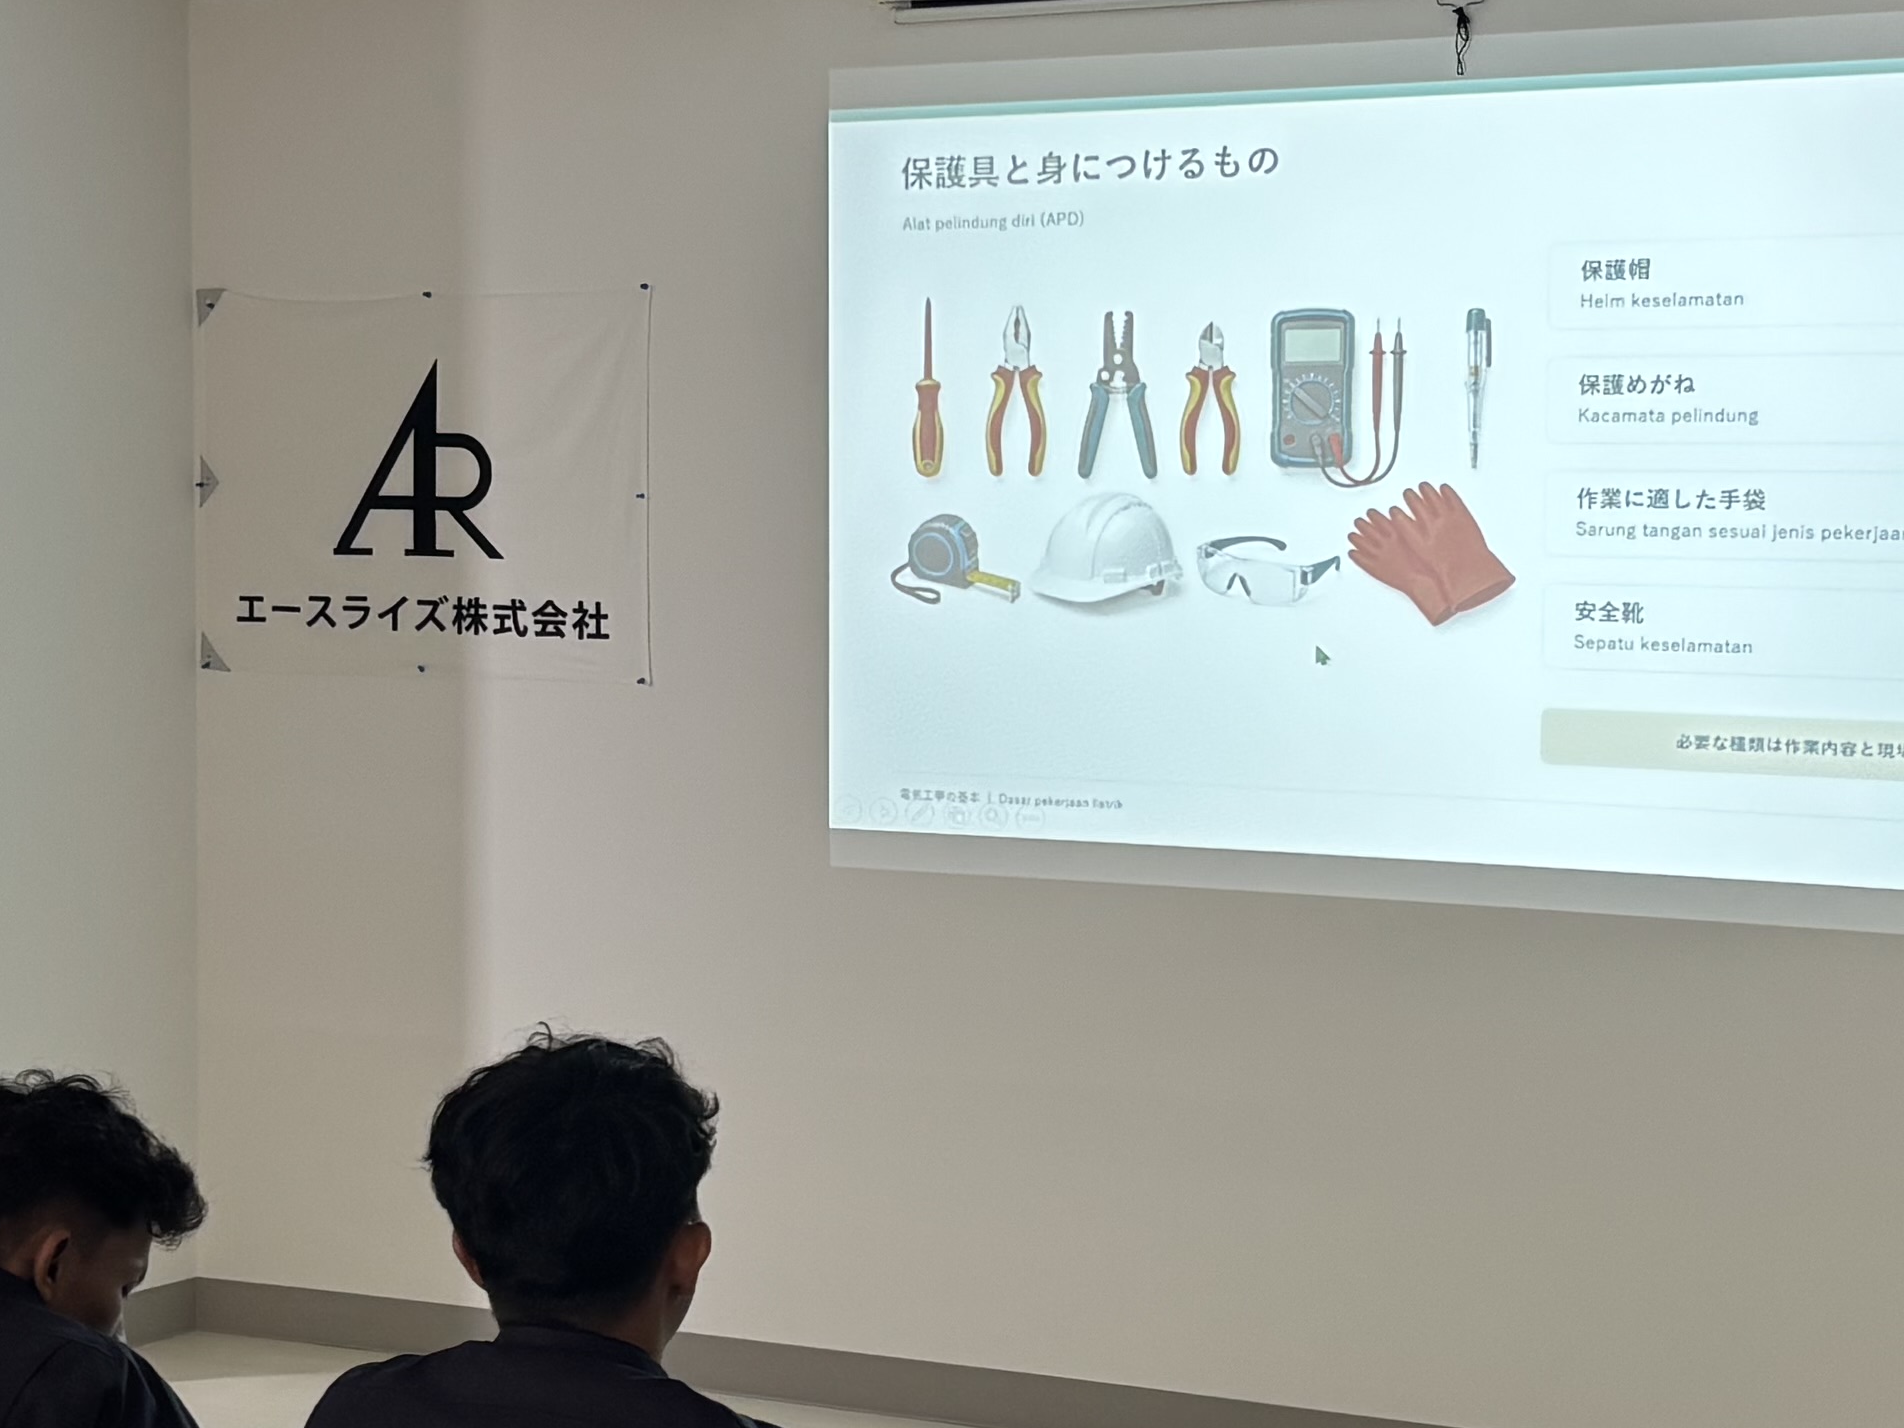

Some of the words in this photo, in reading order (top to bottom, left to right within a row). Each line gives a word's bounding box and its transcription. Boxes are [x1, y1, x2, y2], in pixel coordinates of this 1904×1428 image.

[901, 144, 1280, 191] 保護具と身につけるもの
[902, 216, 931, 232] Alat
[934, 213, 1008, 234] pelindung
[1039, 209, 1085, 229] (APD)
[1580, 257, 1651, 282] 保護帽
[1580, 292, 1626, 309] Helm
[1631, 292, 1745, 308] keselamatan
[1578, 373, 1696, 396] 保護めがね
[1578, 407, 1665, 423] Kacamata
[1671, 407, 1759, 426] pelindung
[1575, 486, 1767, 512] 作業に適した手袋
[1575, 520, 1637, 541] Sarung
[1642, 523, 1703, 542] tangan
[1708, 523, 1767, 541] sesuai
[1770, 523, 1815, 542] jenis
[236, 594, 611, 641] エースライズ株式会社
[1574, 600, 1645, 625] 安全靴
[1573, 633, 1635, 653] Sepatu
[1640, 635, 1753, 654] keselamatan
